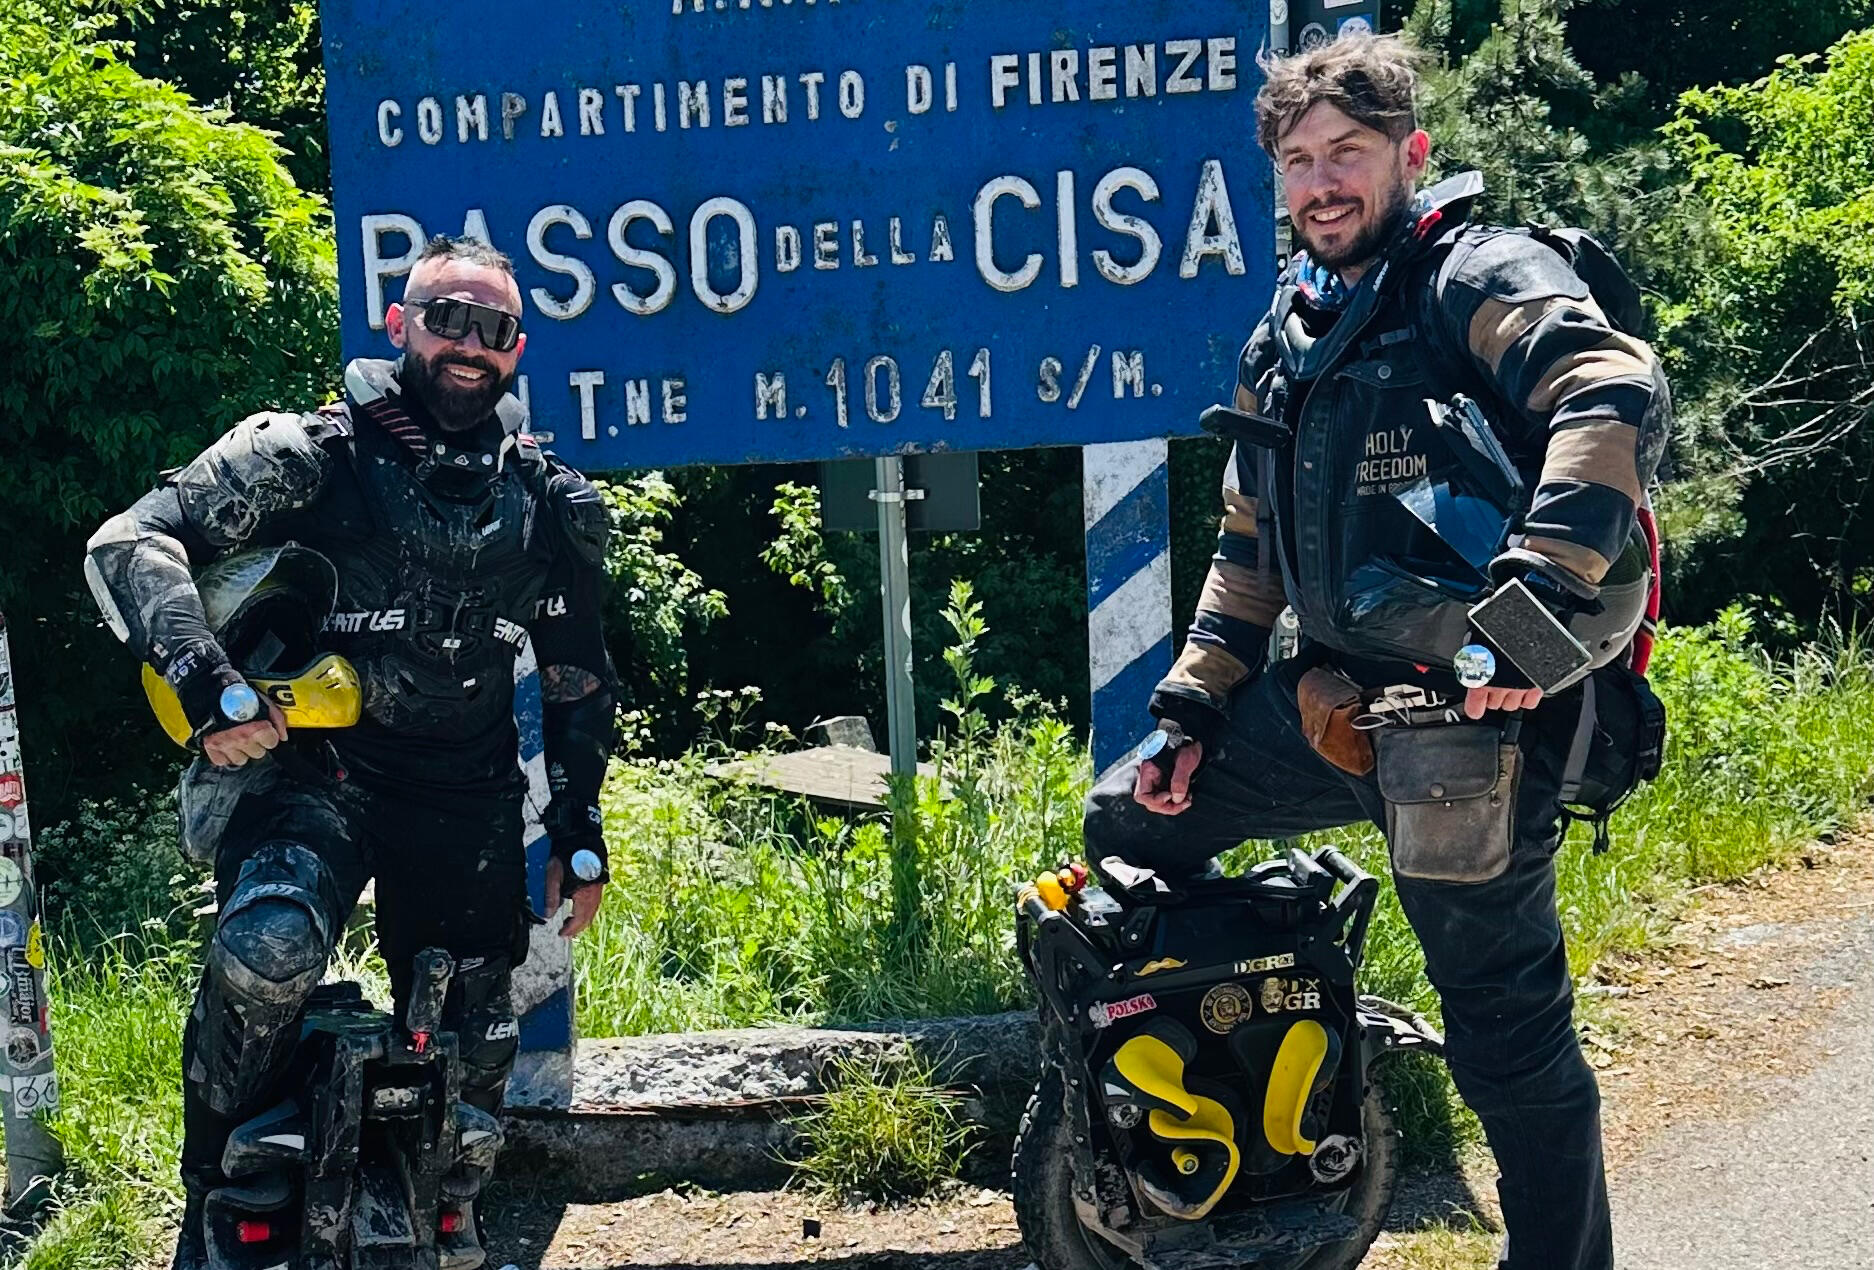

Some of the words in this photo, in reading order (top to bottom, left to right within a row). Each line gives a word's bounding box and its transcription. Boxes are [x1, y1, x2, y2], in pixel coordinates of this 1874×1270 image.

[377, 70, 865, 147] COMPARTIMENTO
[906, 62, 957, 114] DI
[991, 37, 1237, 107] FIRENZE
[775, 215, 954, 272] DELLA
[973, 159, 1246, 292] CISA
[1366, 428, 1413, 457] HOLY
